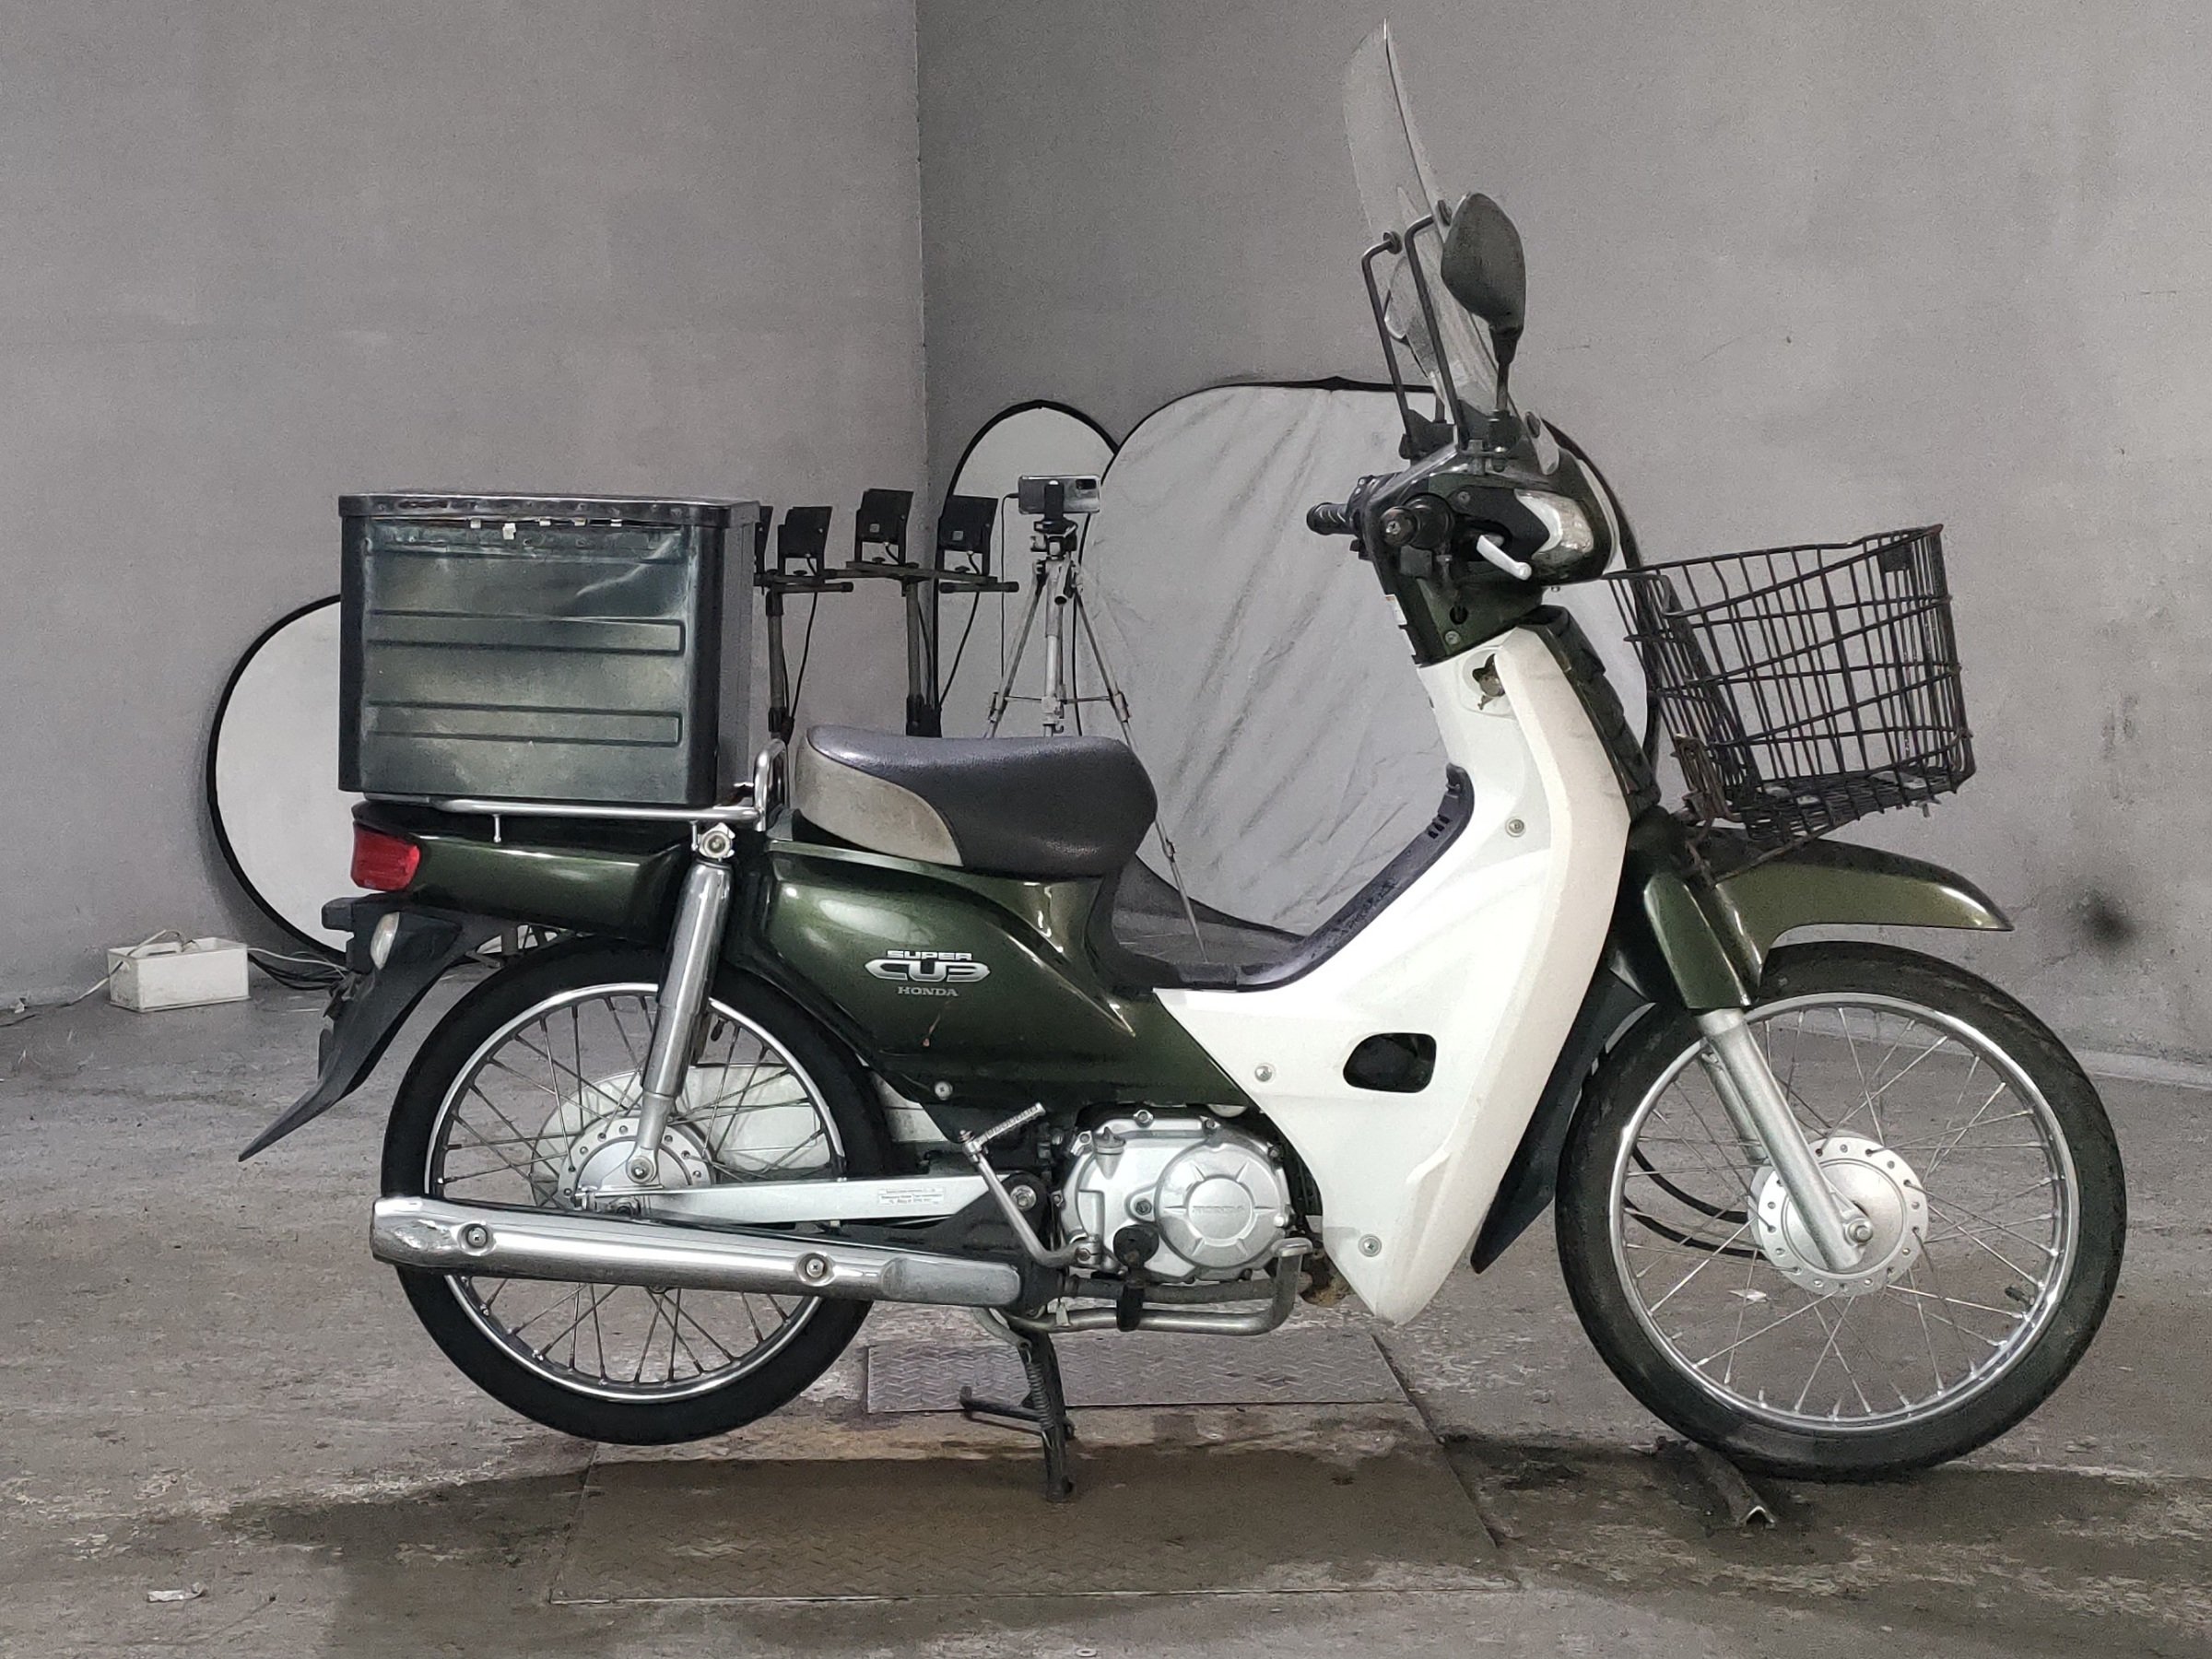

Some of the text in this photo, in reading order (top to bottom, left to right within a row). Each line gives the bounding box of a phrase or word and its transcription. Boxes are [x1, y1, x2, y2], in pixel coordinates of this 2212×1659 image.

[887, 950, 972, 960] SUPER
[865, 959, 991, 982] CUB
[897, 986, 959, 997] HONDA
